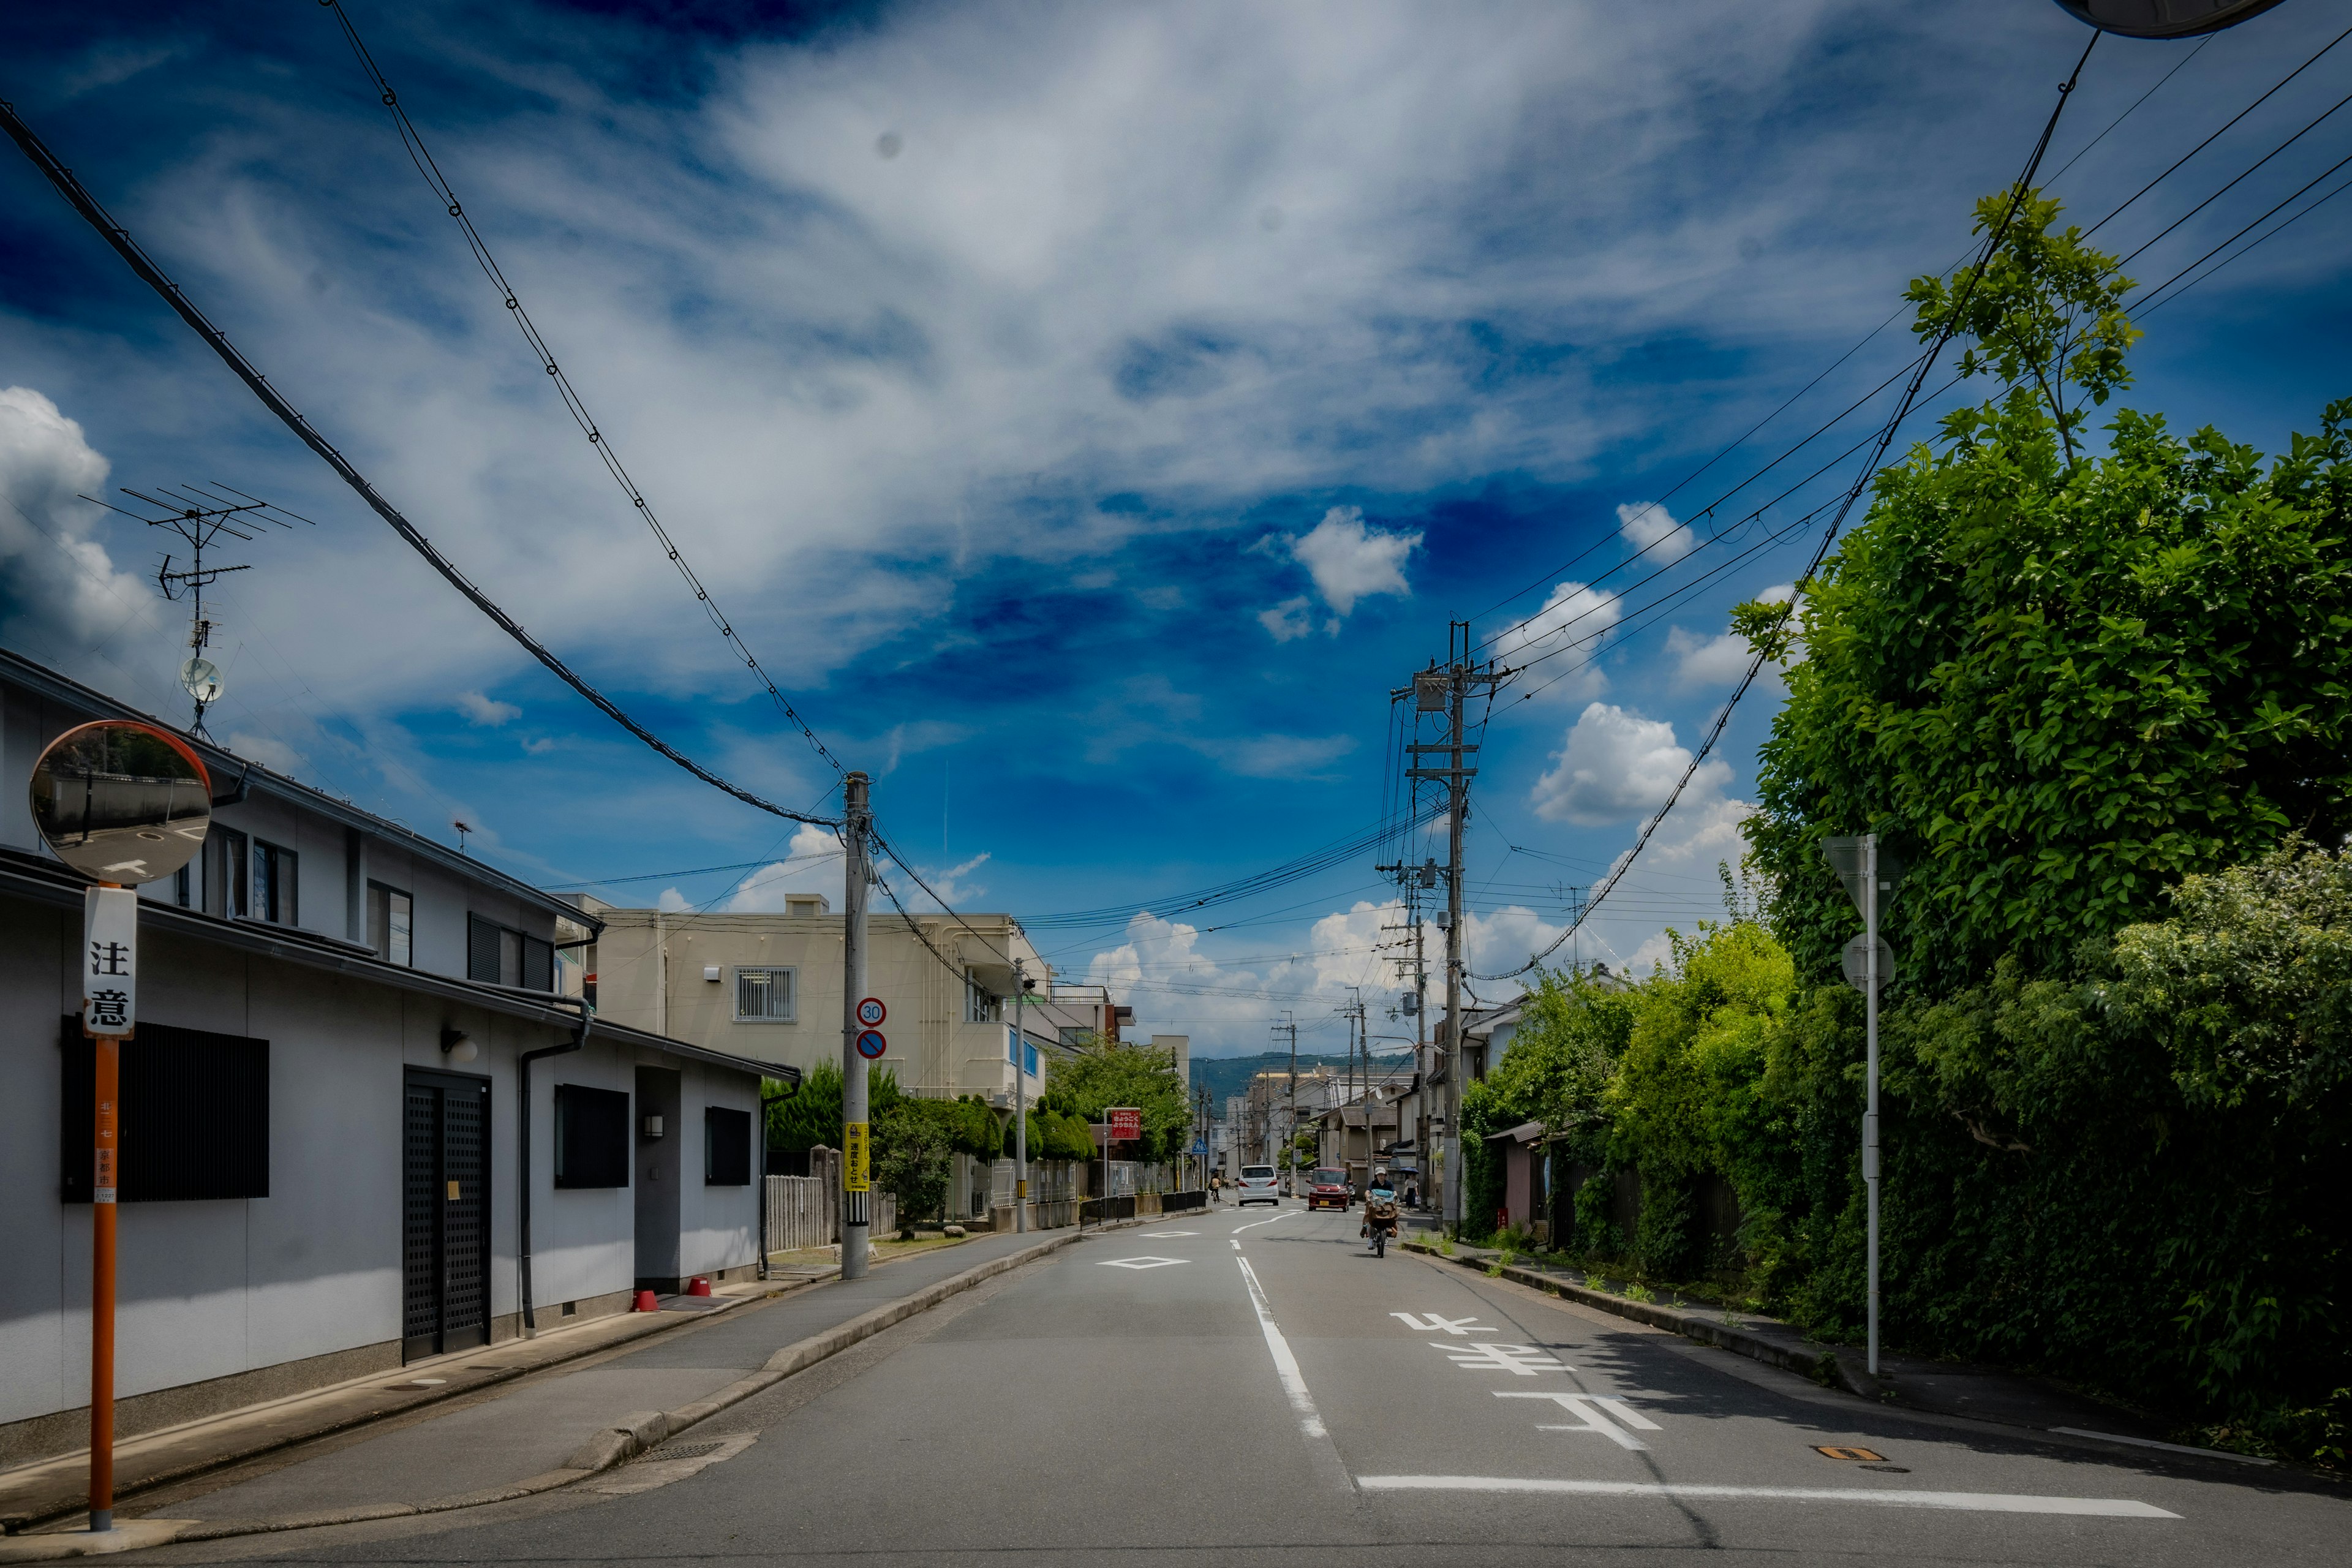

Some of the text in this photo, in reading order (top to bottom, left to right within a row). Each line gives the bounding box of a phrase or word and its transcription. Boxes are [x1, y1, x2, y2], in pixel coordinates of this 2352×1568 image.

[90, 941, 129, 1026] 注意
[864, 1006, 880, 1019] 30
[99, 1151, 110, 1184] 京都市
[850, 1143, 859, 1183] 速度おとせ
